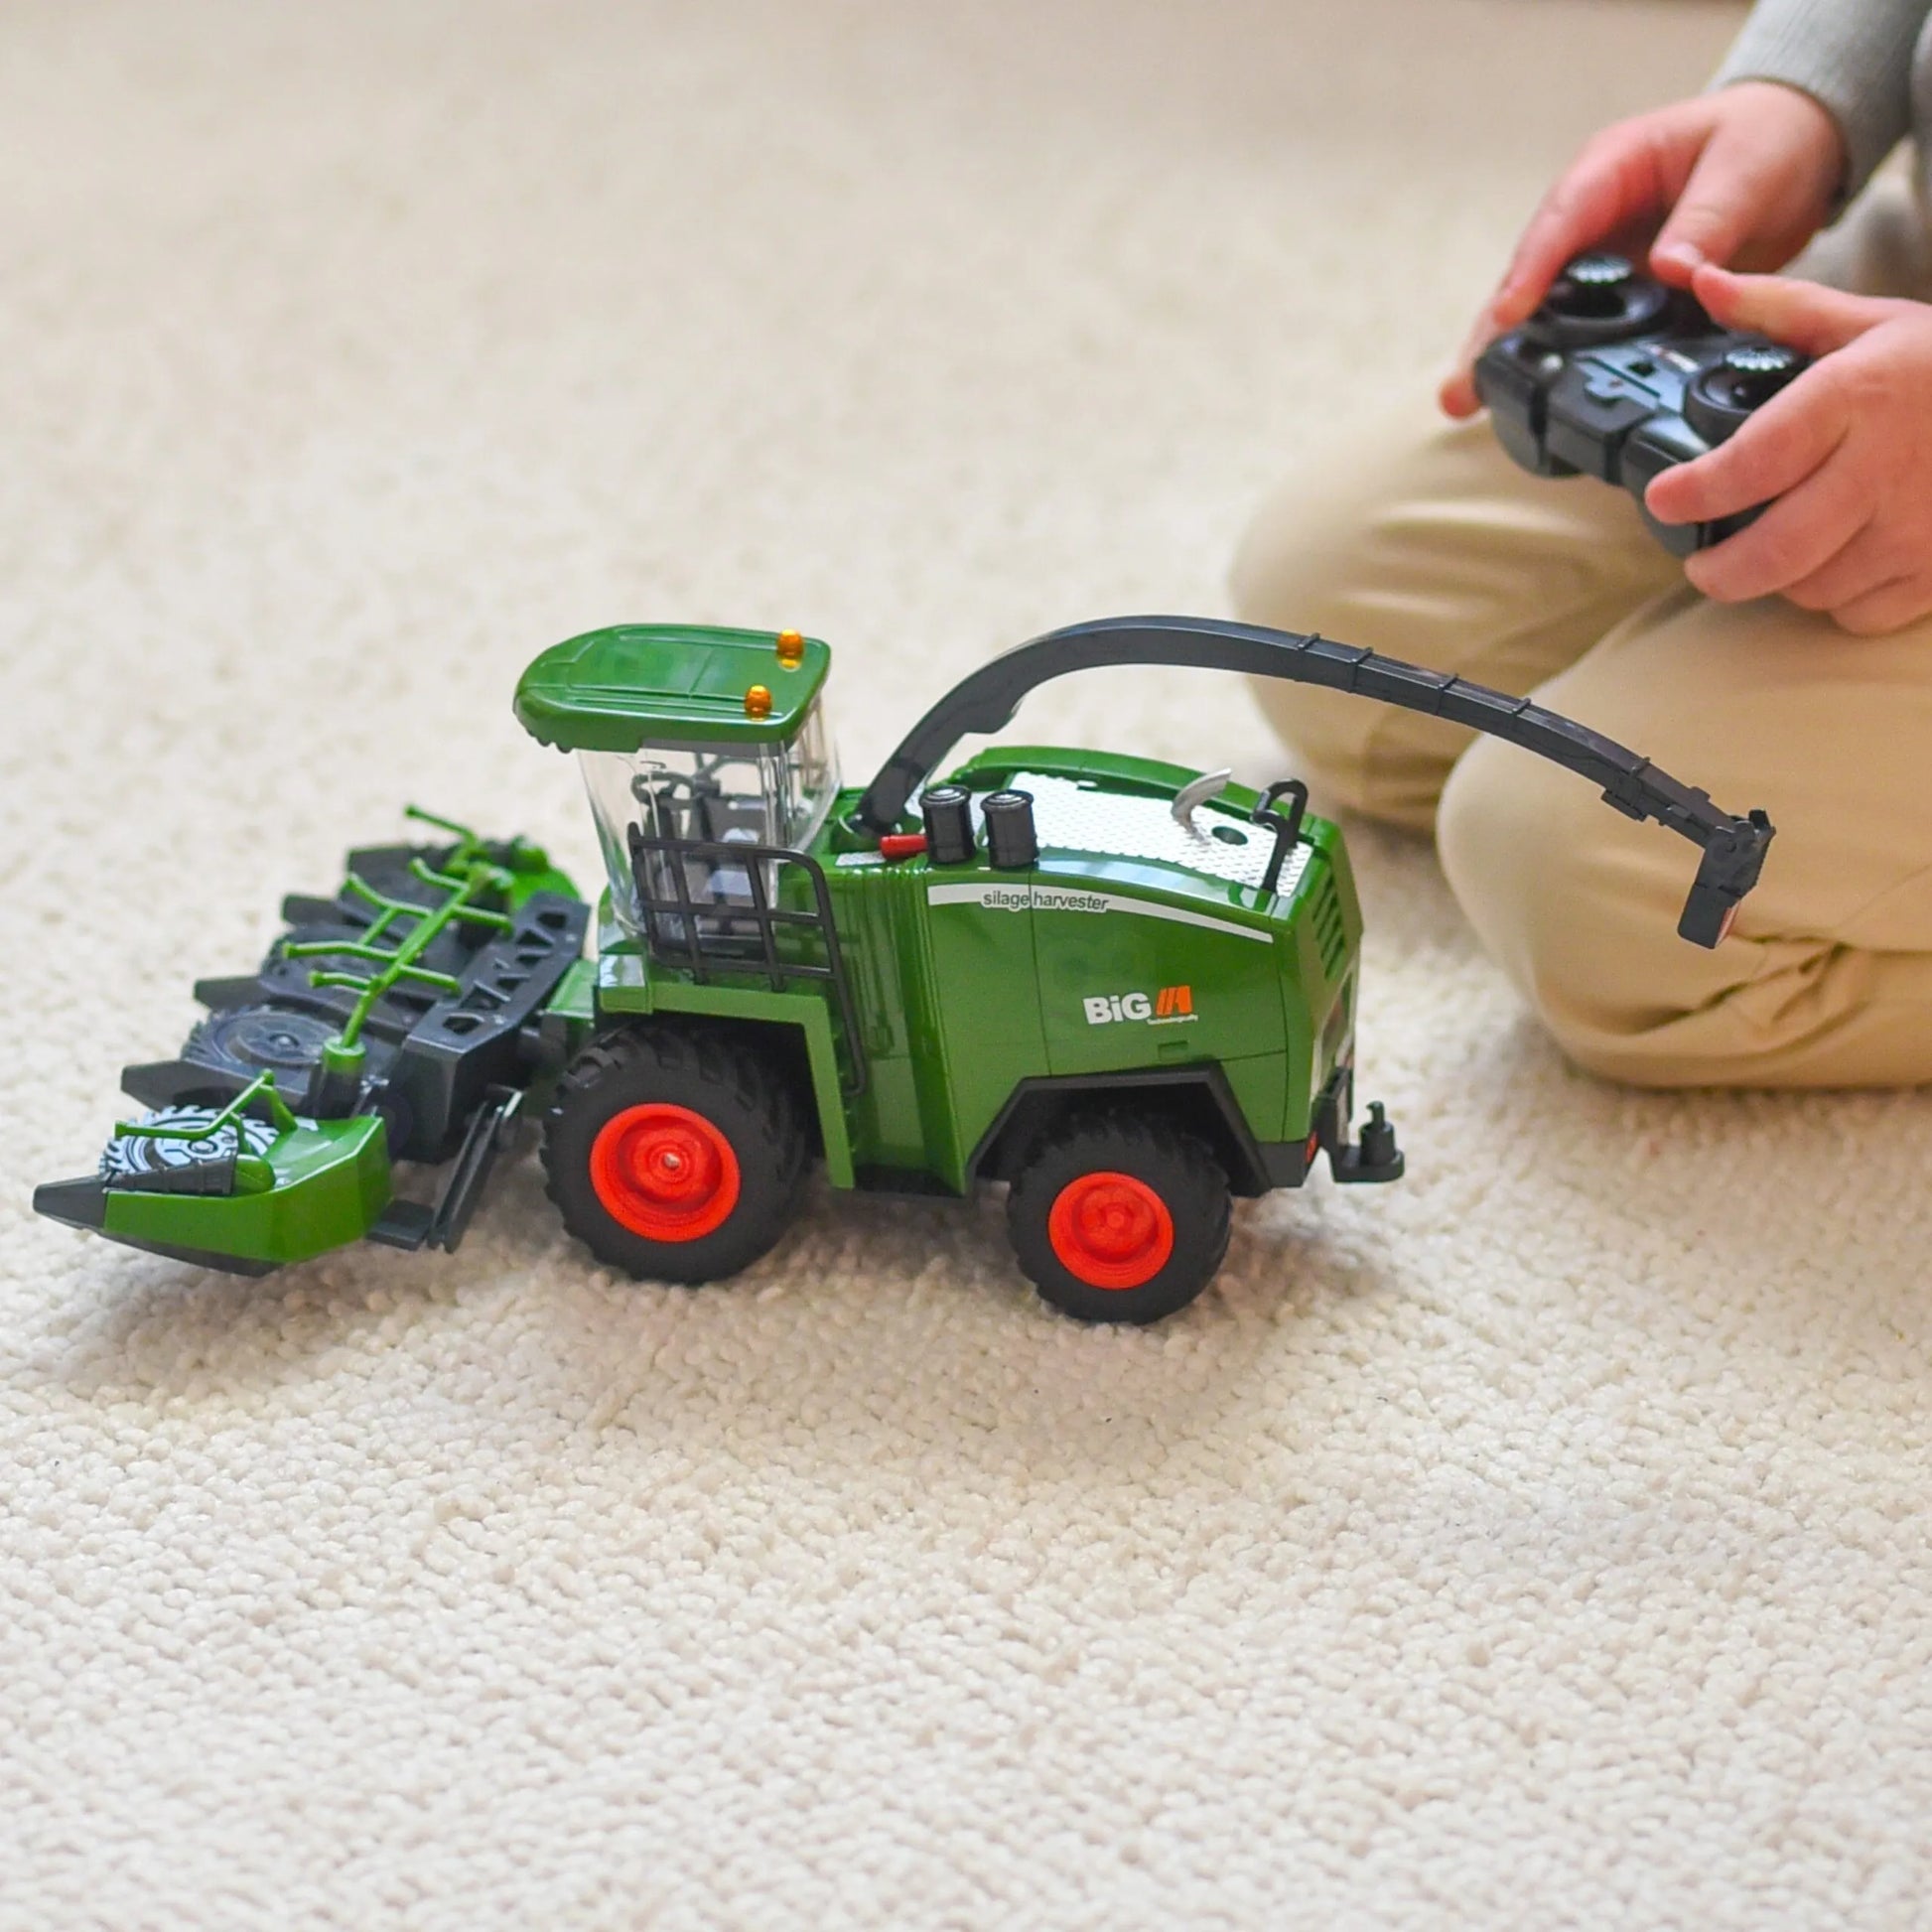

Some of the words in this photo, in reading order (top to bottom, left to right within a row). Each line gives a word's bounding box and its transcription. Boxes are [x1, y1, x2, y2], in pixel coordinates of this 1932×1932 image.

[983, 891, 1030, 908] silage
[1033, 891, 1109, 910] harvester
[1083, 992, 1152, 1025] BiG
